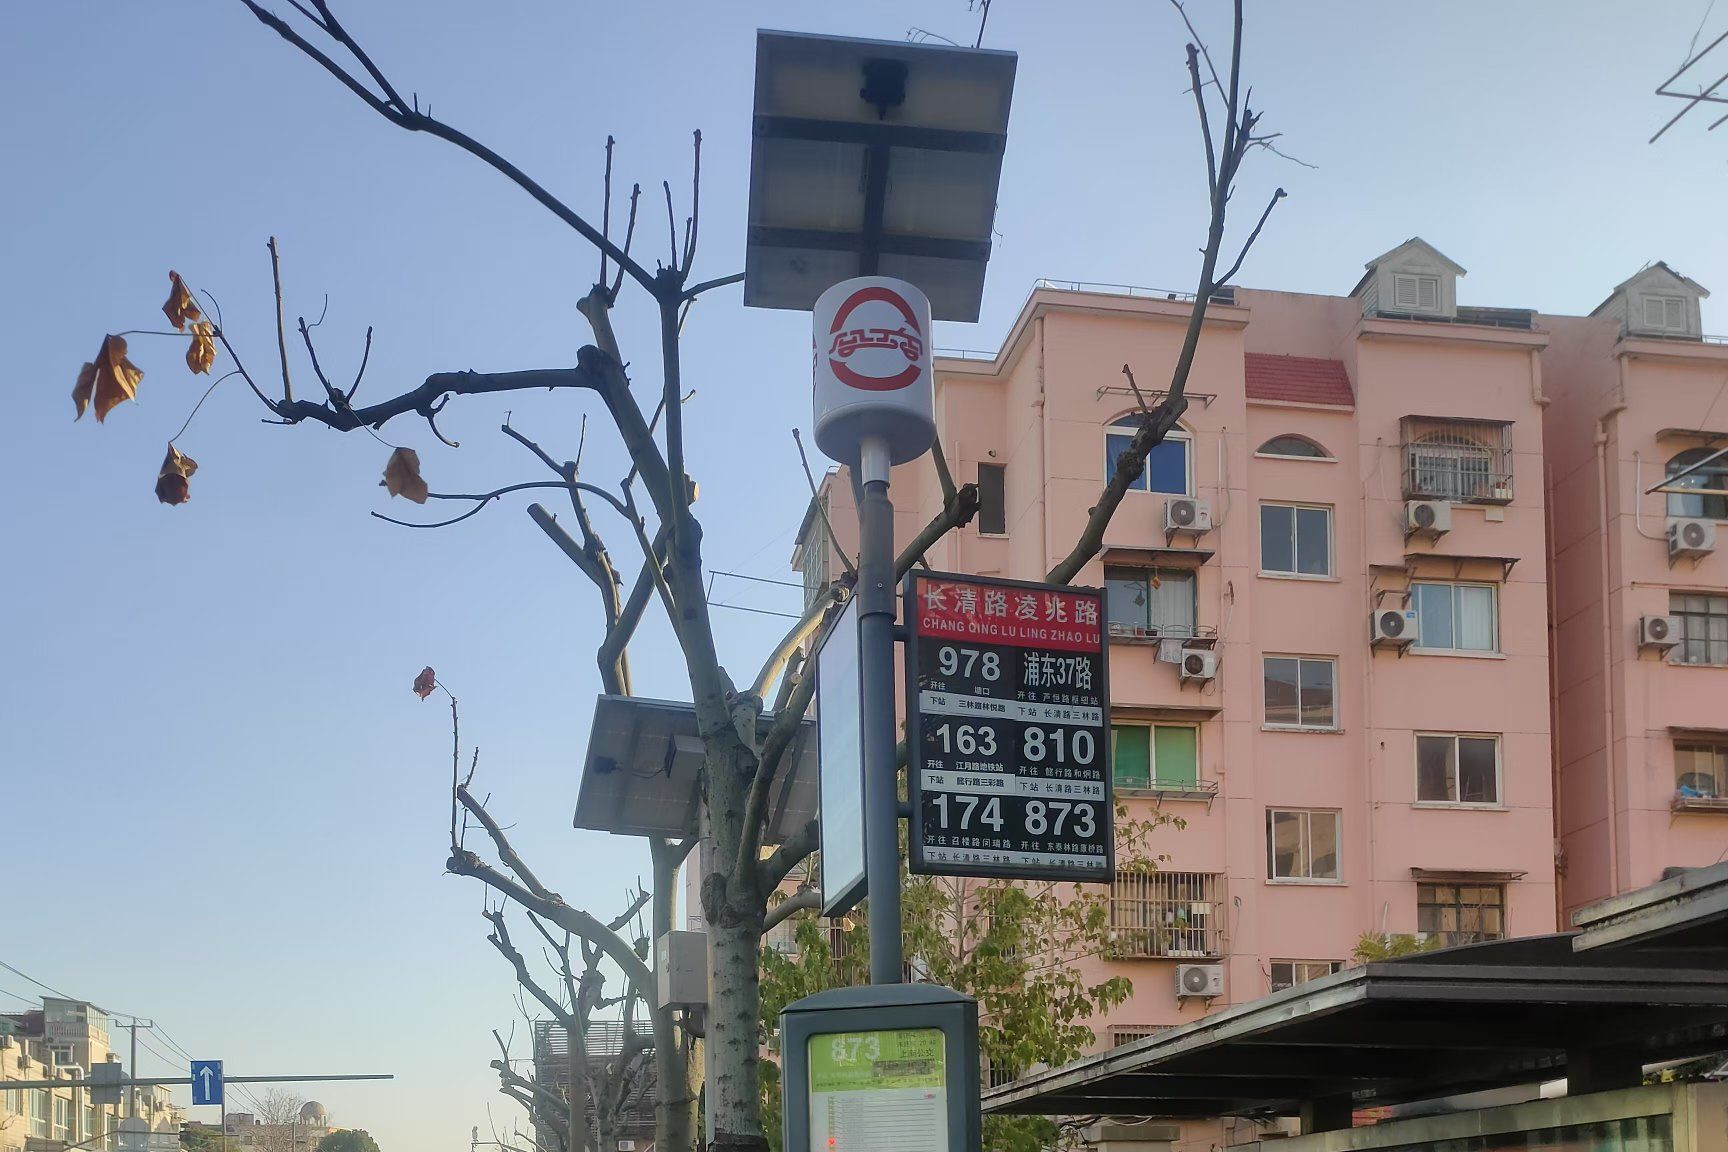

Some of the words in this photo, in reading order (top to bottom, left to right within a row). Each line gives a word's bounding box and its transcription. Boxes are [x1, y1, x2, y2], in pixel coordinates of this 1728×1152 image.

[925, 584, 1098, 626] 长清路凌兆路
[923, 617, 965, 632] CHANG
[968, 622, 998, 635] QING
[1001, 626, 1016, 637] LU
[1020, 627, 1047, 640] LING
[1051, 629, 1082, 643] ZHAO
[1086, 633, 1100, 644] LU
[938, 646, 1001, 682] 978
[1023, 651, 1093, 690] 浦东37路
[930, 680, 946, 691] 开往
[930, 696, 946, 706] 下站
[1017, 690, 1037, 701] 开往
[1018, 707, 1037, 717] 下站
[1044, 708, 1099, 721] 长清路三林路
[936, 723, 997, 756] 163
[1023, 726, 1095, 765] 810
[926, 759, 944, 769] 开往
[1019, 766, 1039, 776] 开往
[927, 775, 944, 785] 下站
[1019, 782, 1039, 792] 下站
[1045, 783, 1100, 795] 长清路三林路
[932, 794, 1004, 832] 174
[1024, 800, 1096, 838] 873
[926, 835, 947, 846] 开往
[1020, 841, 1040, 851] 开往
[831, 1036, 880, 1062] 873
